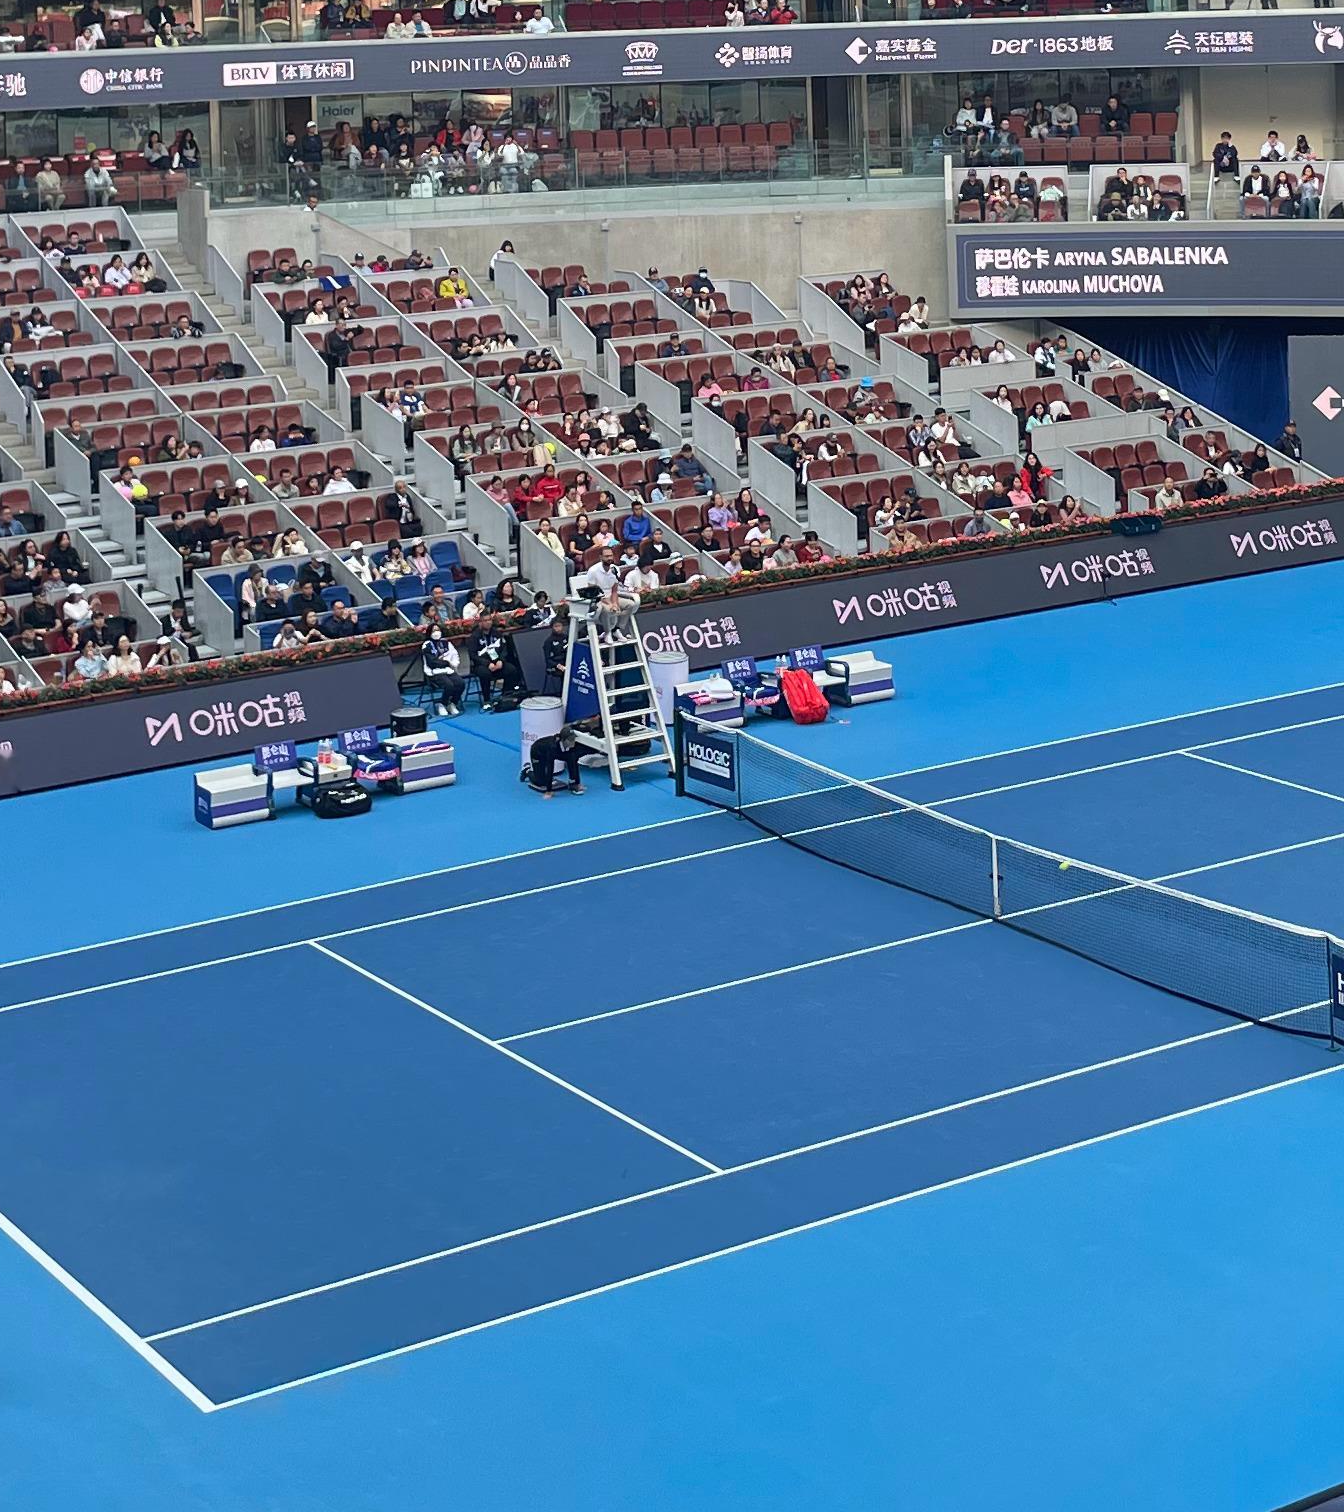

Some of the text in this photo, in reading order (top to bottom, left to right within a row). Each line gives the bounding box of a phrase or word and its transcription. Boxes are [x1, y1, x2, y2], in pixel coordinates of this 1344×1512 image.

[874, 37, 937, 53] 嘉实基金
[1194, 31, 1254, 46] 天坛整装
[741, 45, 792, 61] 智扬体育
[231, 62, 347, 80] BRTV 体育休闲
[411, 57, 504, 74] PINPINTEA
[104, 66, 164, 84] 中信银行
[322, 105, 355, 119] Haier
[974, 247, 1050, 271] 萨巴伦卡
[1054, 252, 1107, 266] ARYNA
[1110, 246, 1229, 266] SABALENKA
[975, 274, 1020, 298] 穆霍娃
[1021, 279, 1081, 294] KAROLINA
[1083, 274, 1164, 294] MUCHOVA
[688, 741, 730, 766] HOLOGIC
